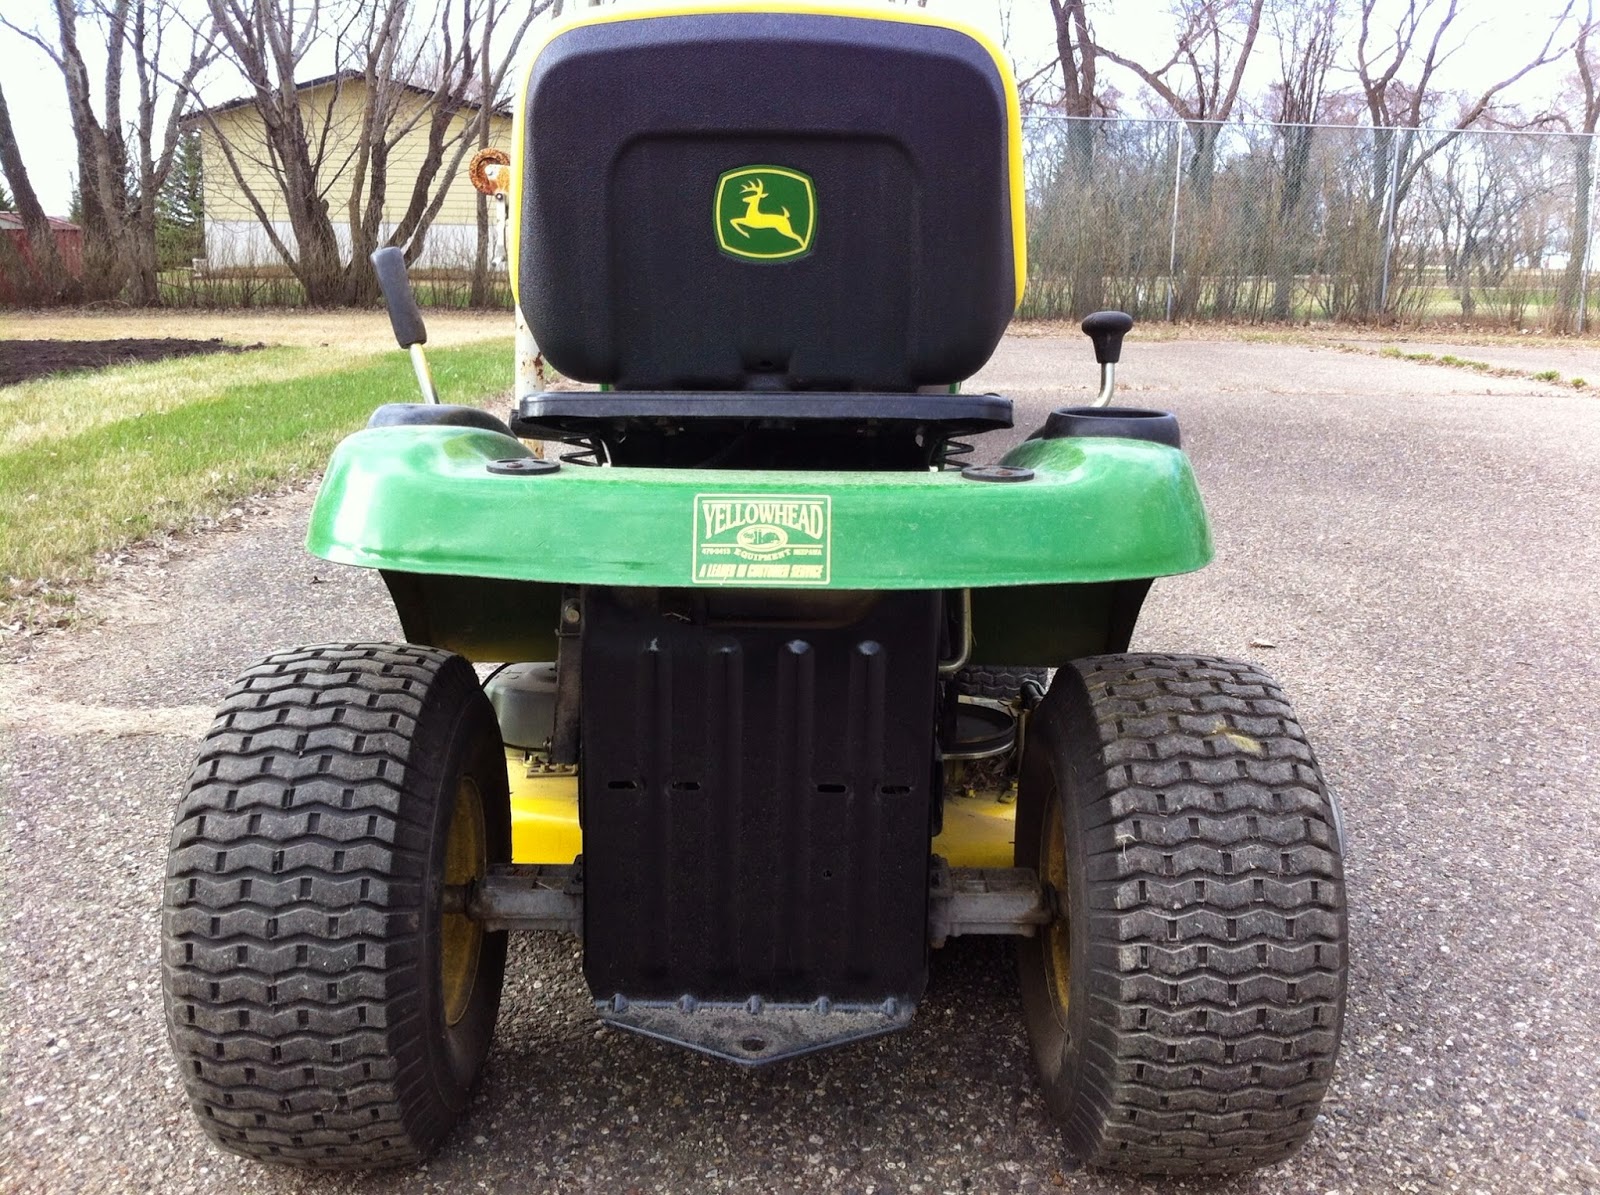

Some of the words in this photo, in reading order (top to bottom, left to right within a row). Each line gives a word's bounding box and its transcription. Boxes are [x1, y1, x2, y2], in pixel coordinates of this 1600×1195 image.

[702, 503, 824, 540] YELLOWHEAD
[733, 548, 791, 561] EQUIPMENT
[699, 563, 707, 578] A
[706, 563, 737, 578] LEADER
[747, 564, 790, 578] CUSTOMER
[790, 564, 823, 579] SERVICE
